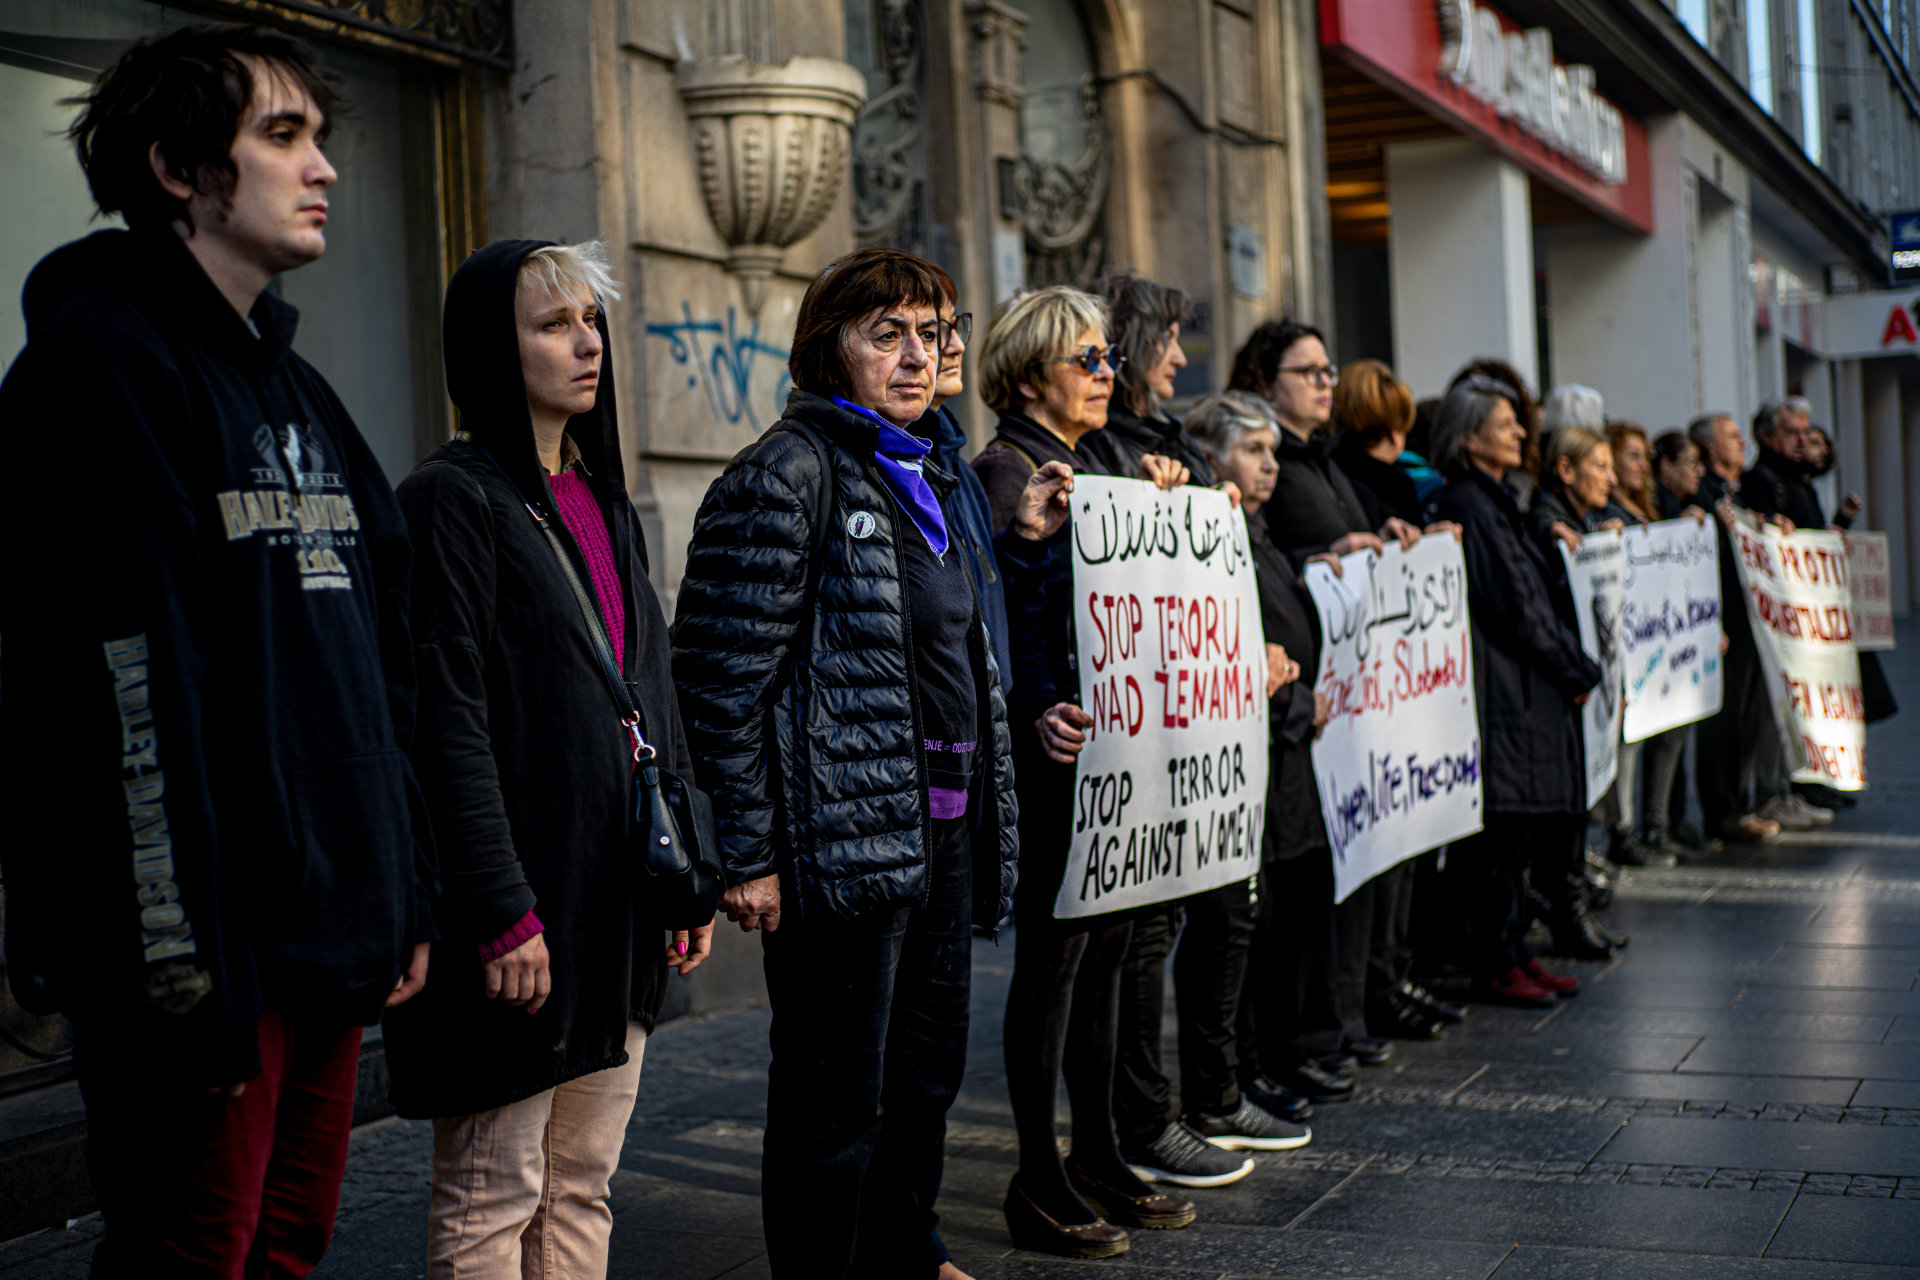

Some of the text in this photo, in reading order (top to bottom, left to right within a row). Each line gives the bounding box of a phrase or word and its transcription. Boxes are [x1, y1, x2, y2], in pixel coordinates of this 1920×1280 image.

[1089, 591, 1240, 672] STOP TERORU
[1091, 674, 1144, 742] NAD
[104, 634, 196, 962] HARLEY-DAVIDSON
[1076, 742, 1246, 834] STOP TERROR
